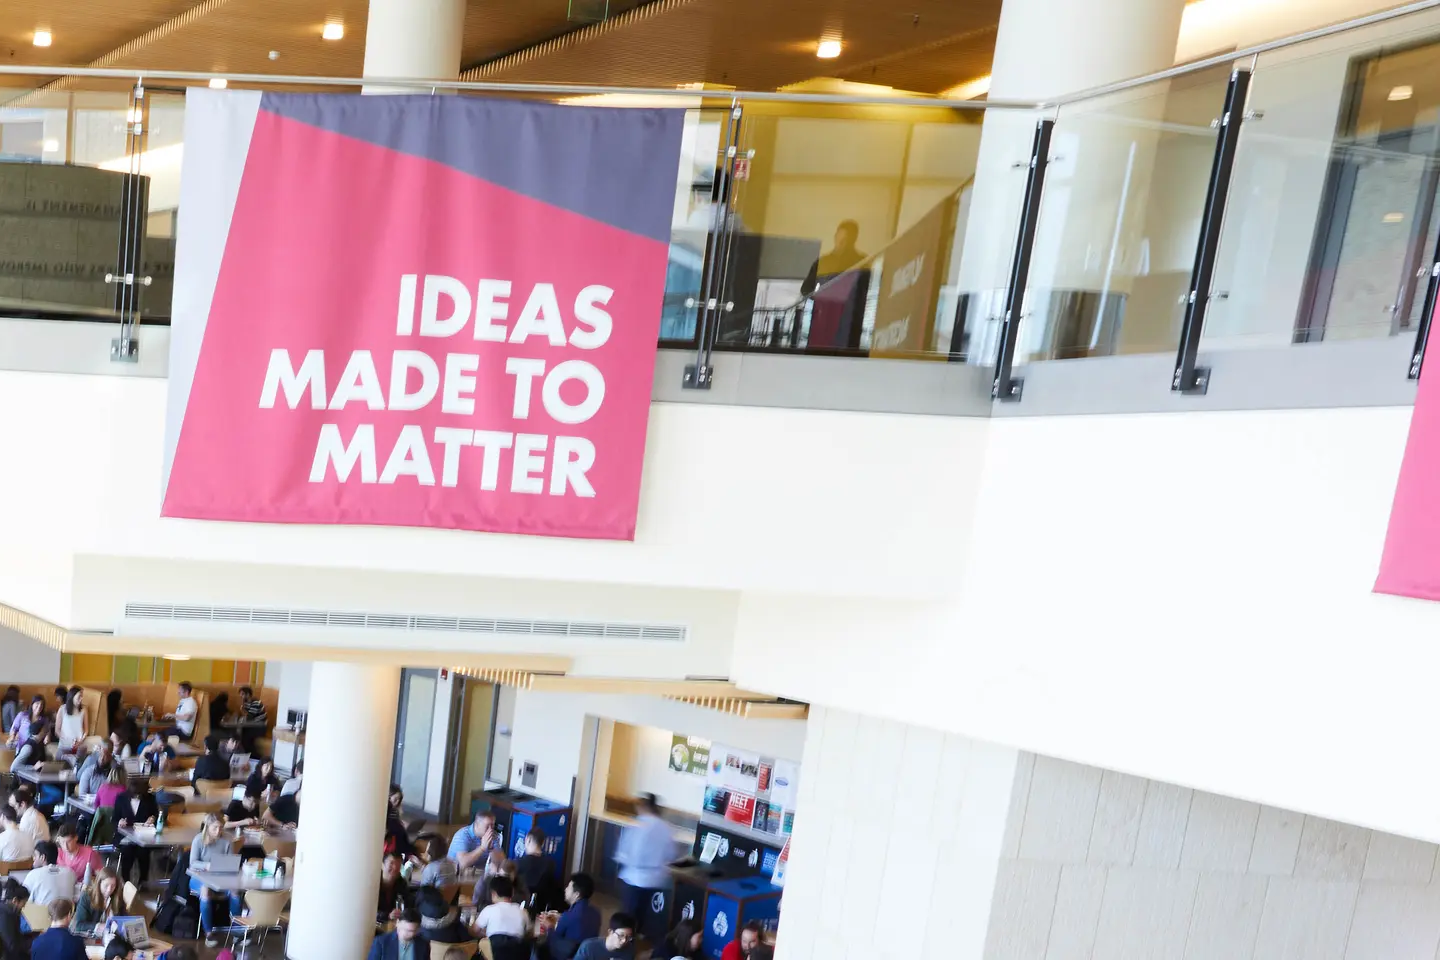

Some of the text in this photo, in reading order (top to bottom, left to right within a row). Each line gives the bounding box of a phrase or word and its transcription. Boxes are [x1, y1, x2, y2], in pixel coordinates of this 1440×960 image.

[396, 274, 614, 349] IDEAS
[258, 348, 606, 424] MADE TO
[308, 424, 597, 498] MATTER
